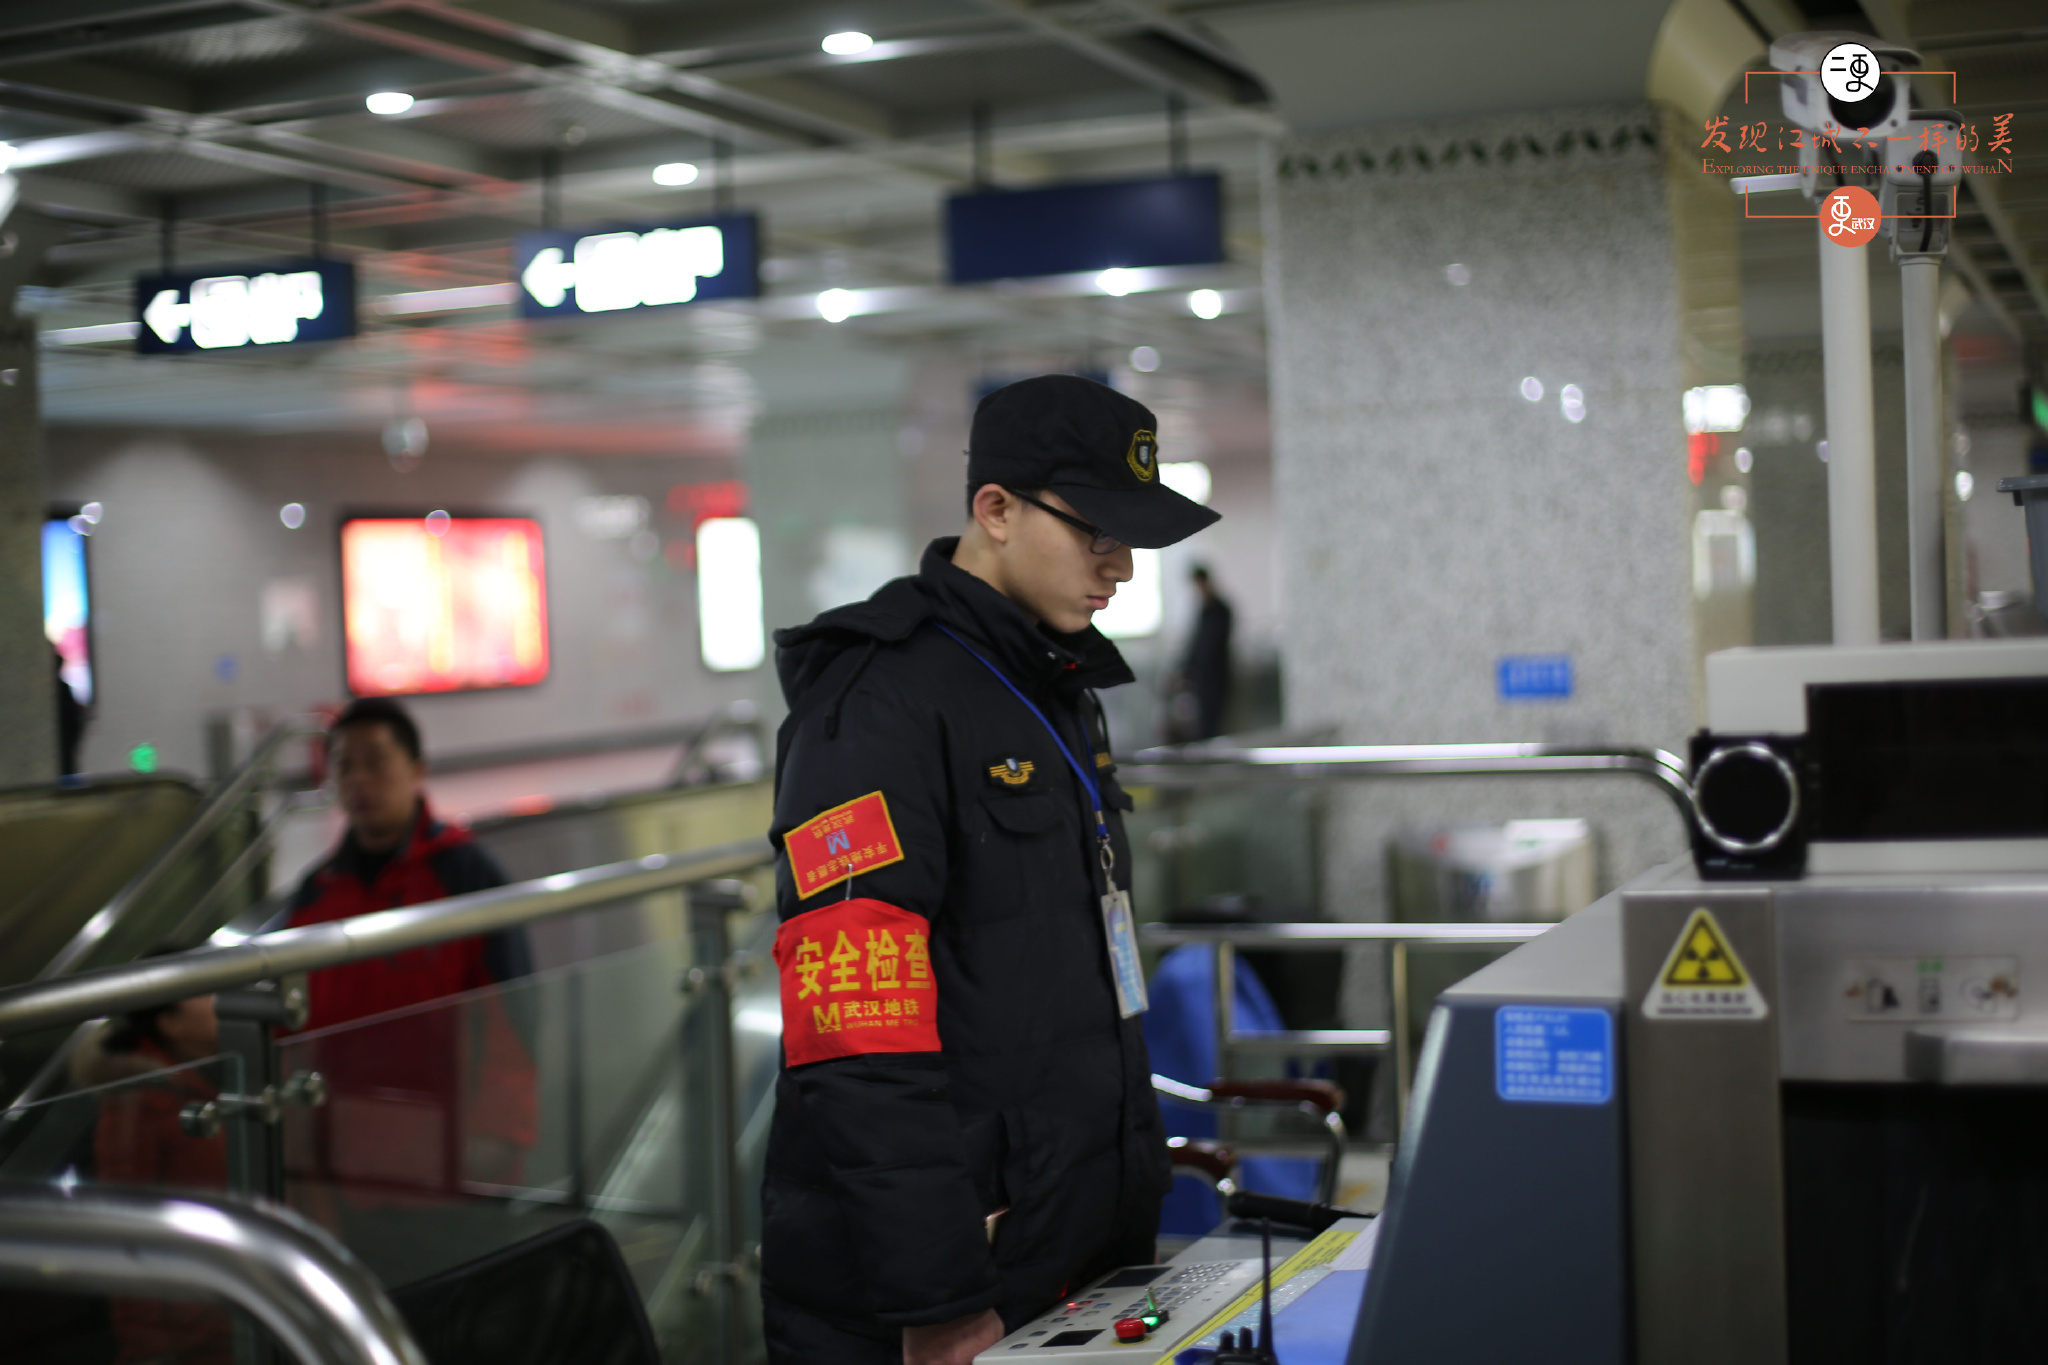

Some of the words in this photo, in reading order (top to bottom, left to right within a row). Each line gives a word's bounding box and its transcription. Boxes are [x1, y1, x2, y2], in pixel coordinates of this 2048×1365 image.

[796, 929, 931, 1000] 安全检查
[843, 998, 920, 1018] 武汉地铁
